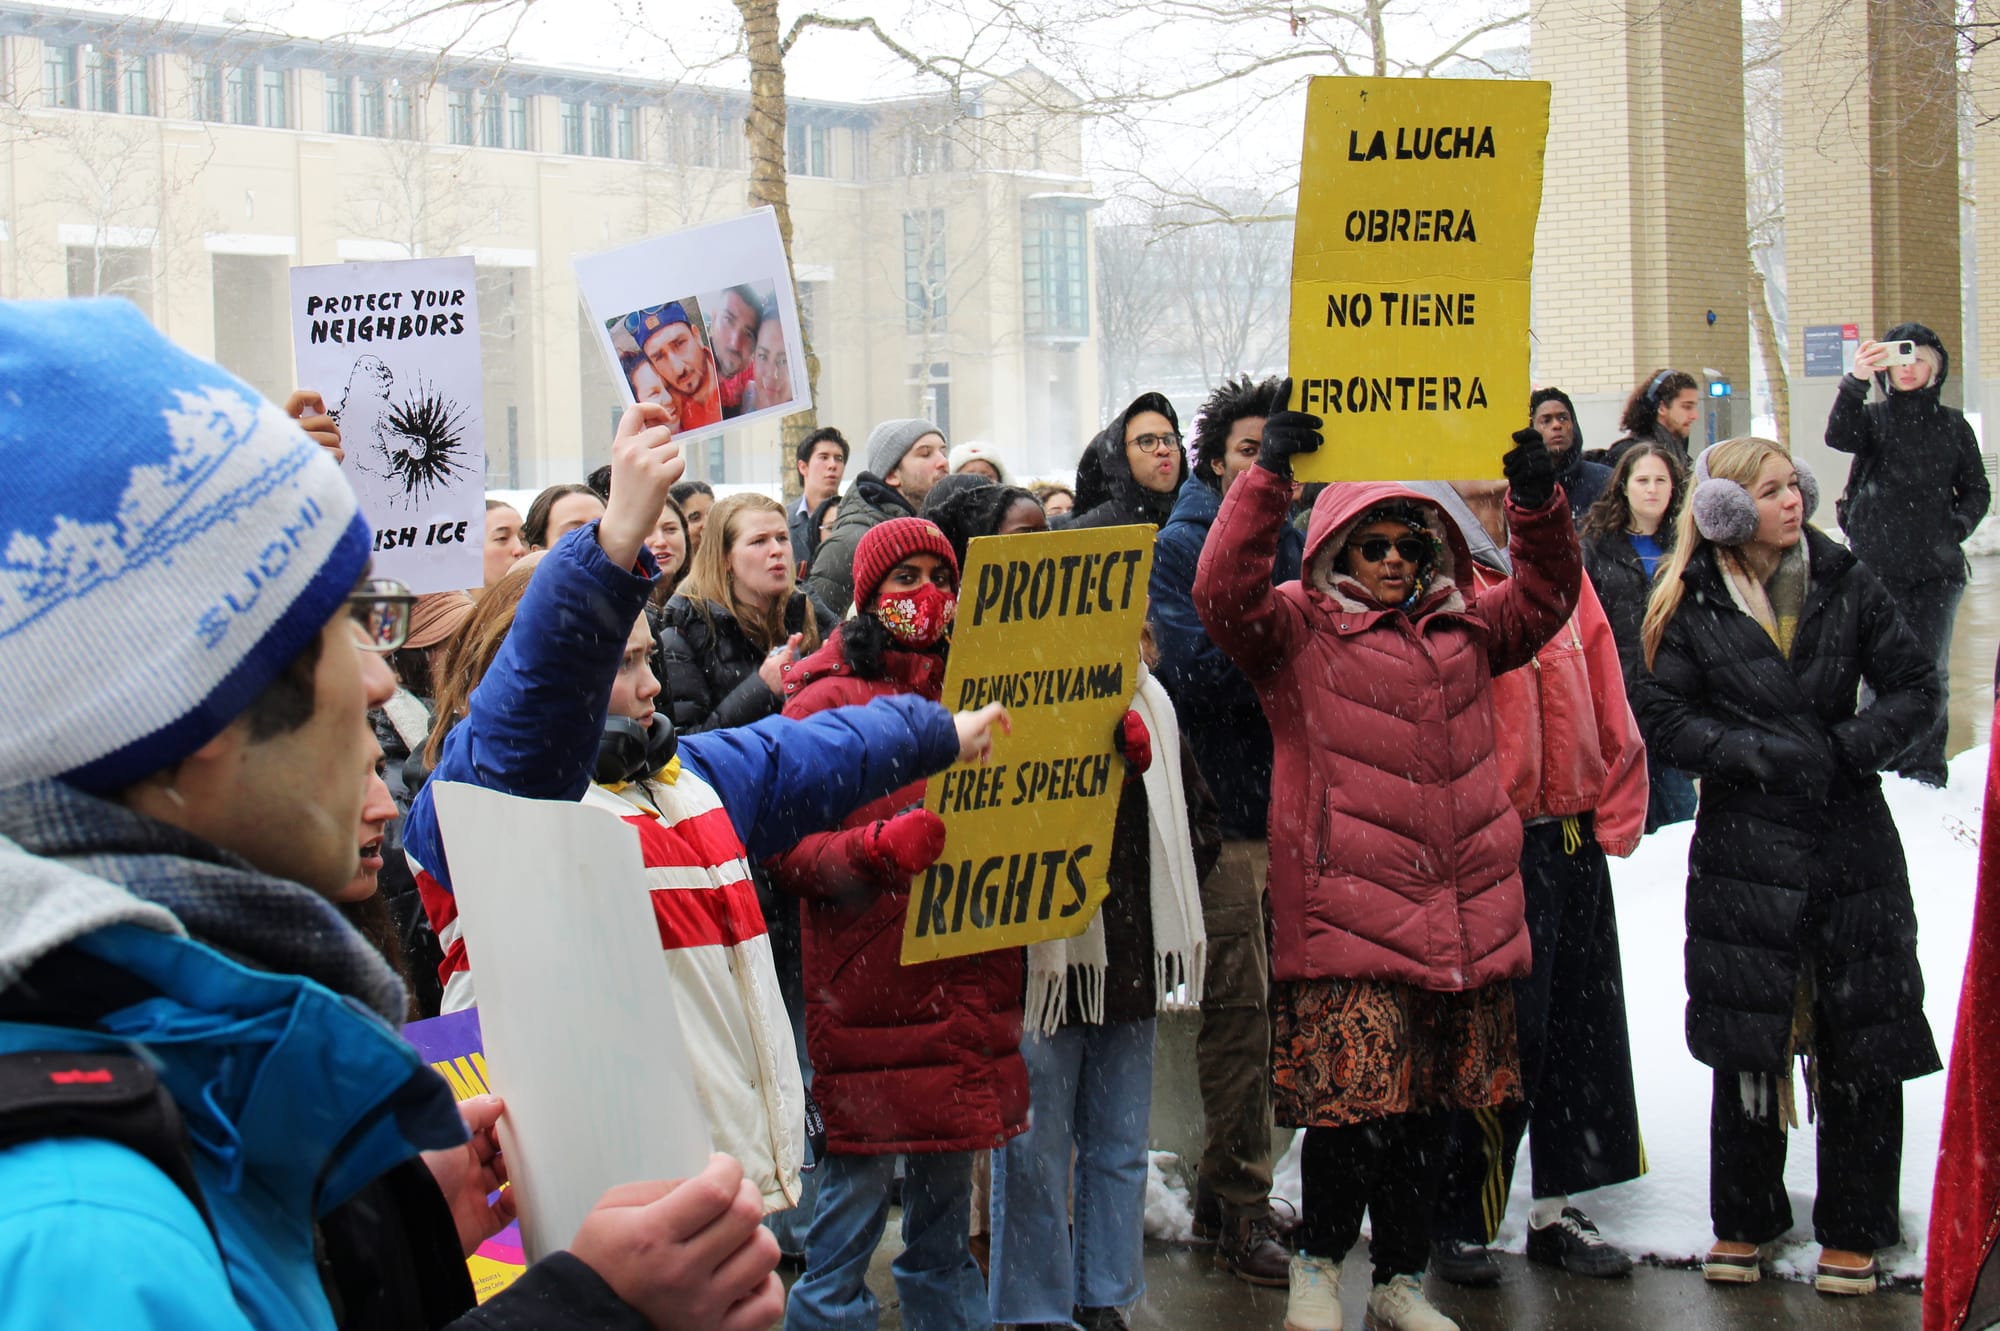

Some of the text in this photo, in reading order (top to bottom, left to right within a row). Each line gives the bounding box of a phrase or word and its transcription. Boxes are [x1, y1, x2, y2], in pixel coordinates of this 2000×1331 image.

[1348, 126, 1496, 162] LA LUCHA
[1344, 208, 1477, 243] OBRERA
[306, 289, 466, 316] PROTECT YOUR
[1326, 292, 1476, 328] NO TIENE
[310, 311, 465, 345] NEIGHBORS
[1300, 376, 1488, 414] FRONTERA
[424, 520, 469, 546] ICE
[972, 549, 1143, 627] PROTECT
[938, 752, 1111, 815] FREE SPEECH
[914, 844, 1093, 938] RIGHTS
